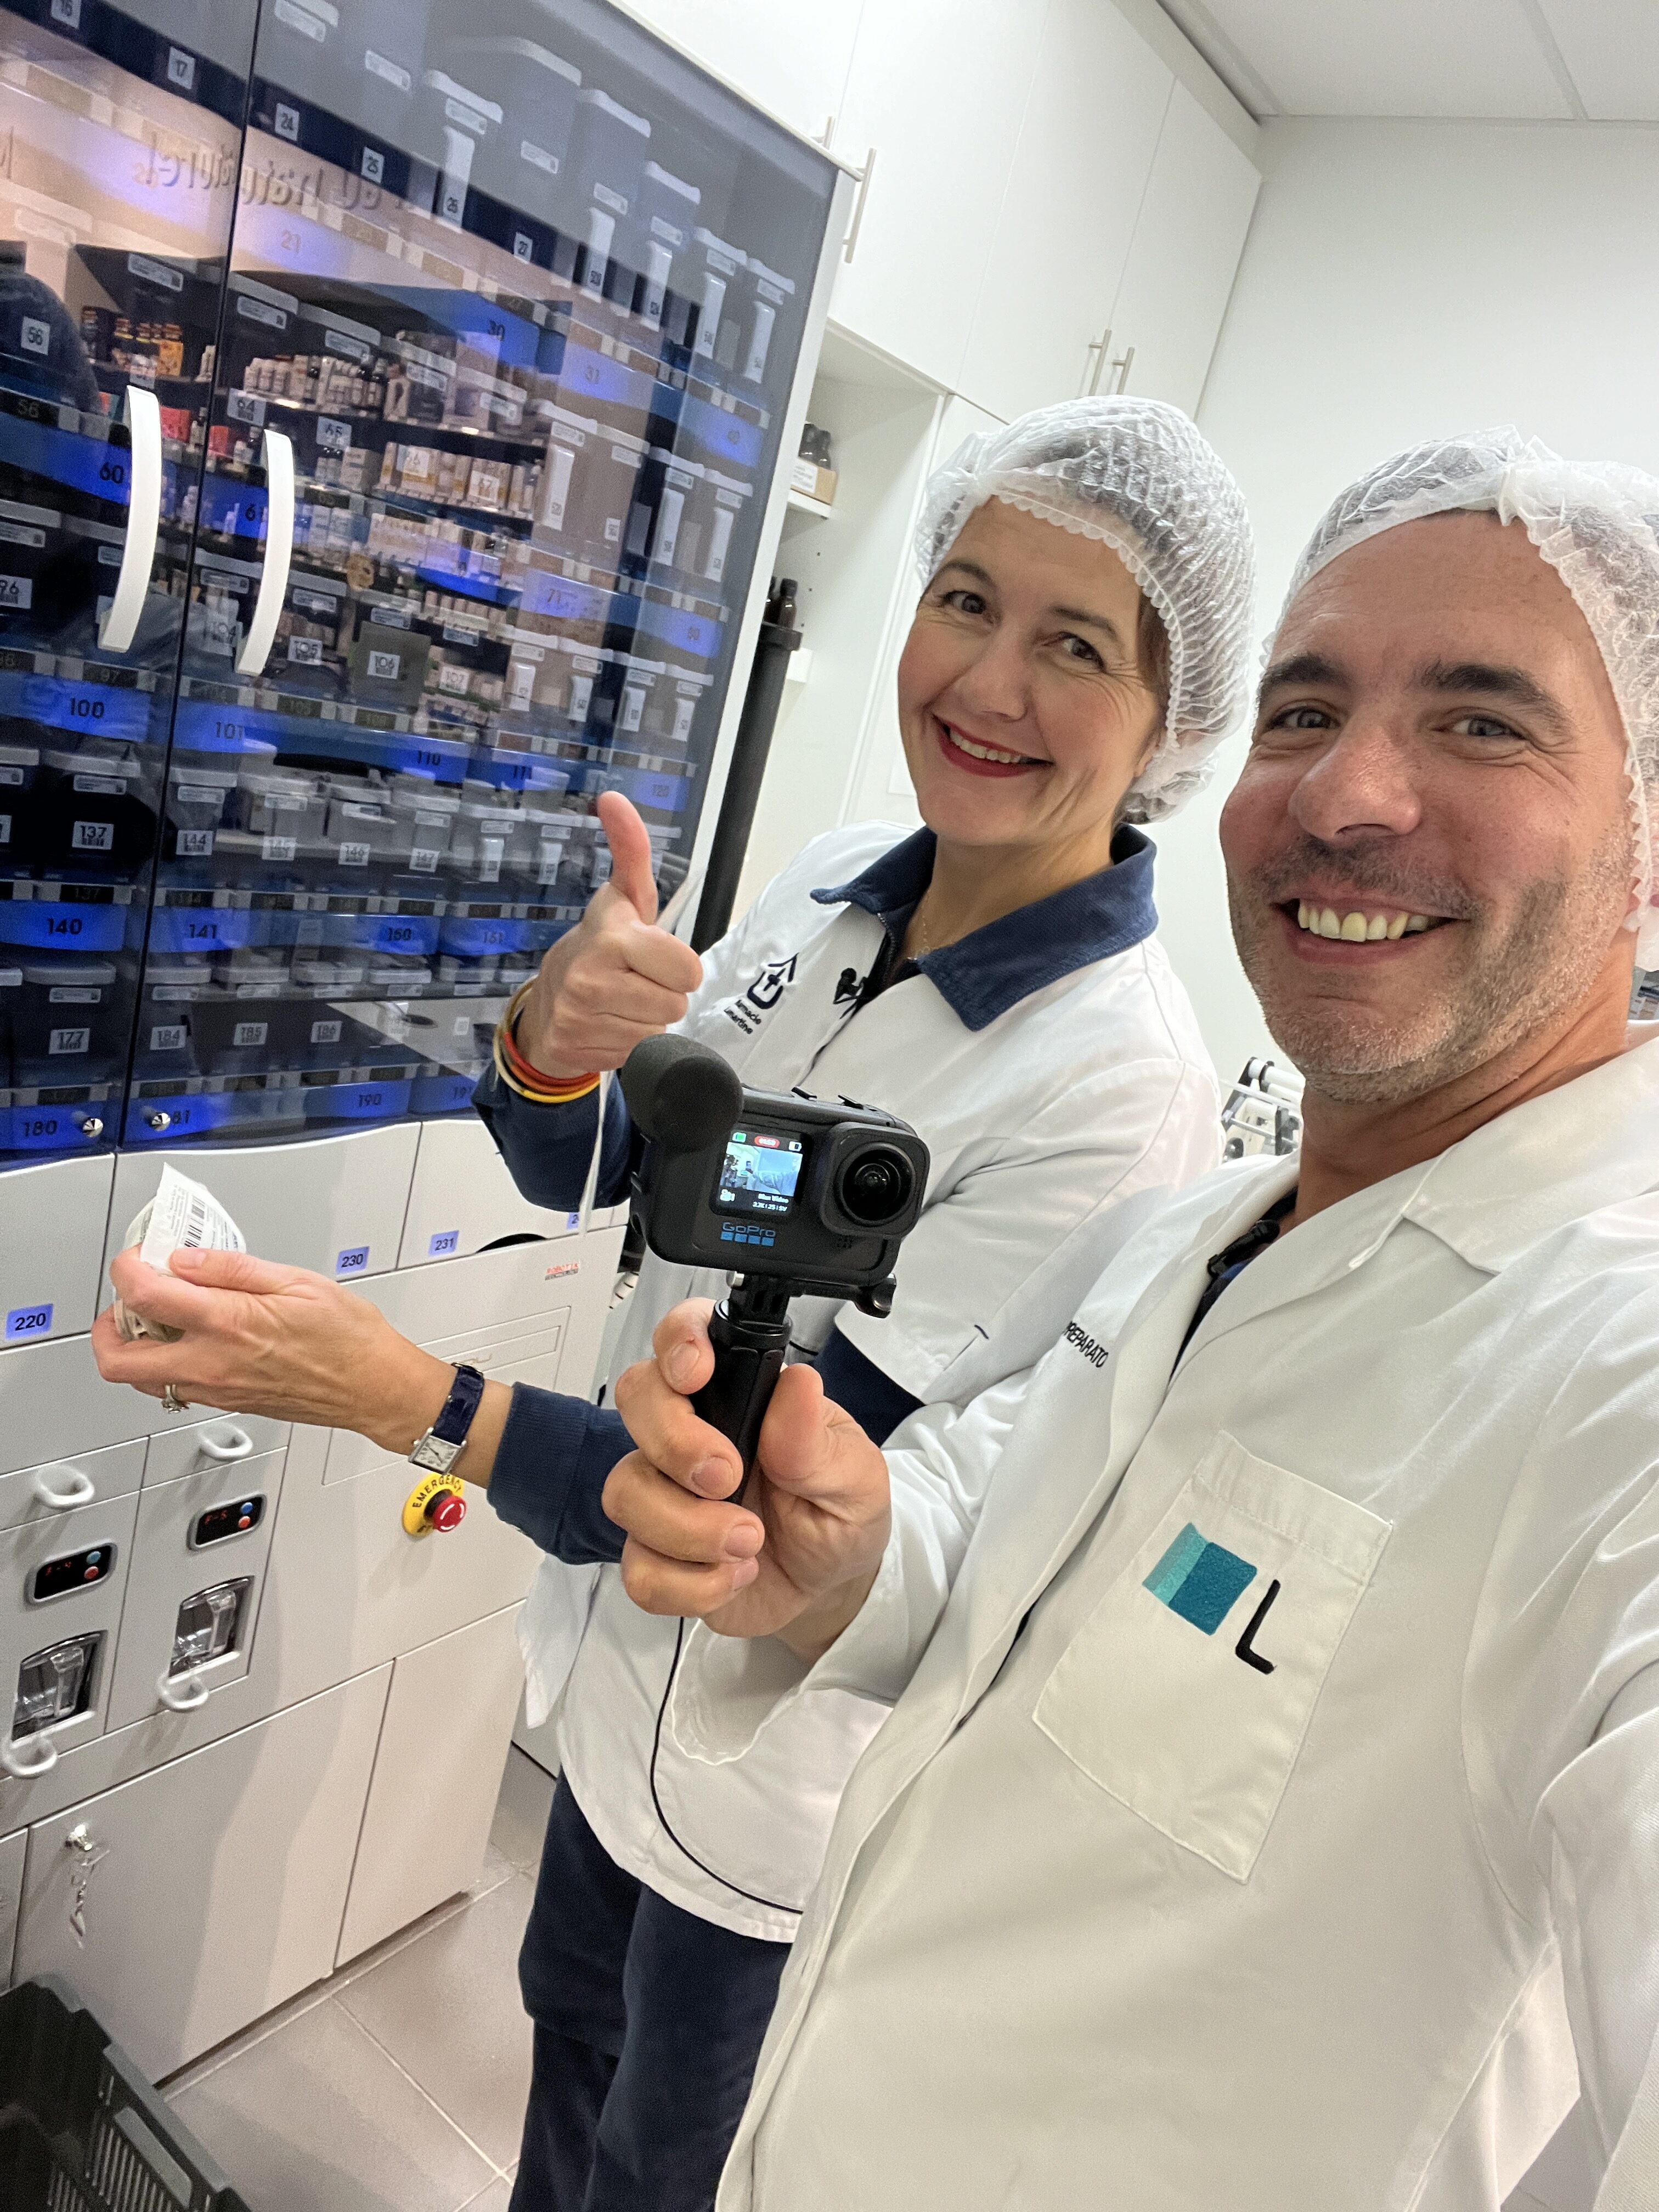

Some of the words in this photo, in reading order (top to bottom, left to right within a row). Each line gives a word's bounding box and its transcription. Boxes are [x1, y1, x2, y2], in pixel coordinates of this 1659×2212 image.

[99, 461, 125, 484] 60
[70, 697, 105, 720] 100
[80, 825, 107, 838] 137
[47, 918, 83, 935] 140
[189, 923, 218, 940] 141
[722, 1222, 776, 1238] GoPro
[434, 1237, 454, 1251] 231
[341, 1253, 364, 1268] 230
[14, 1312, 47, 1331] 220
[412, 1472, 462, 1508] EMERGENCY
